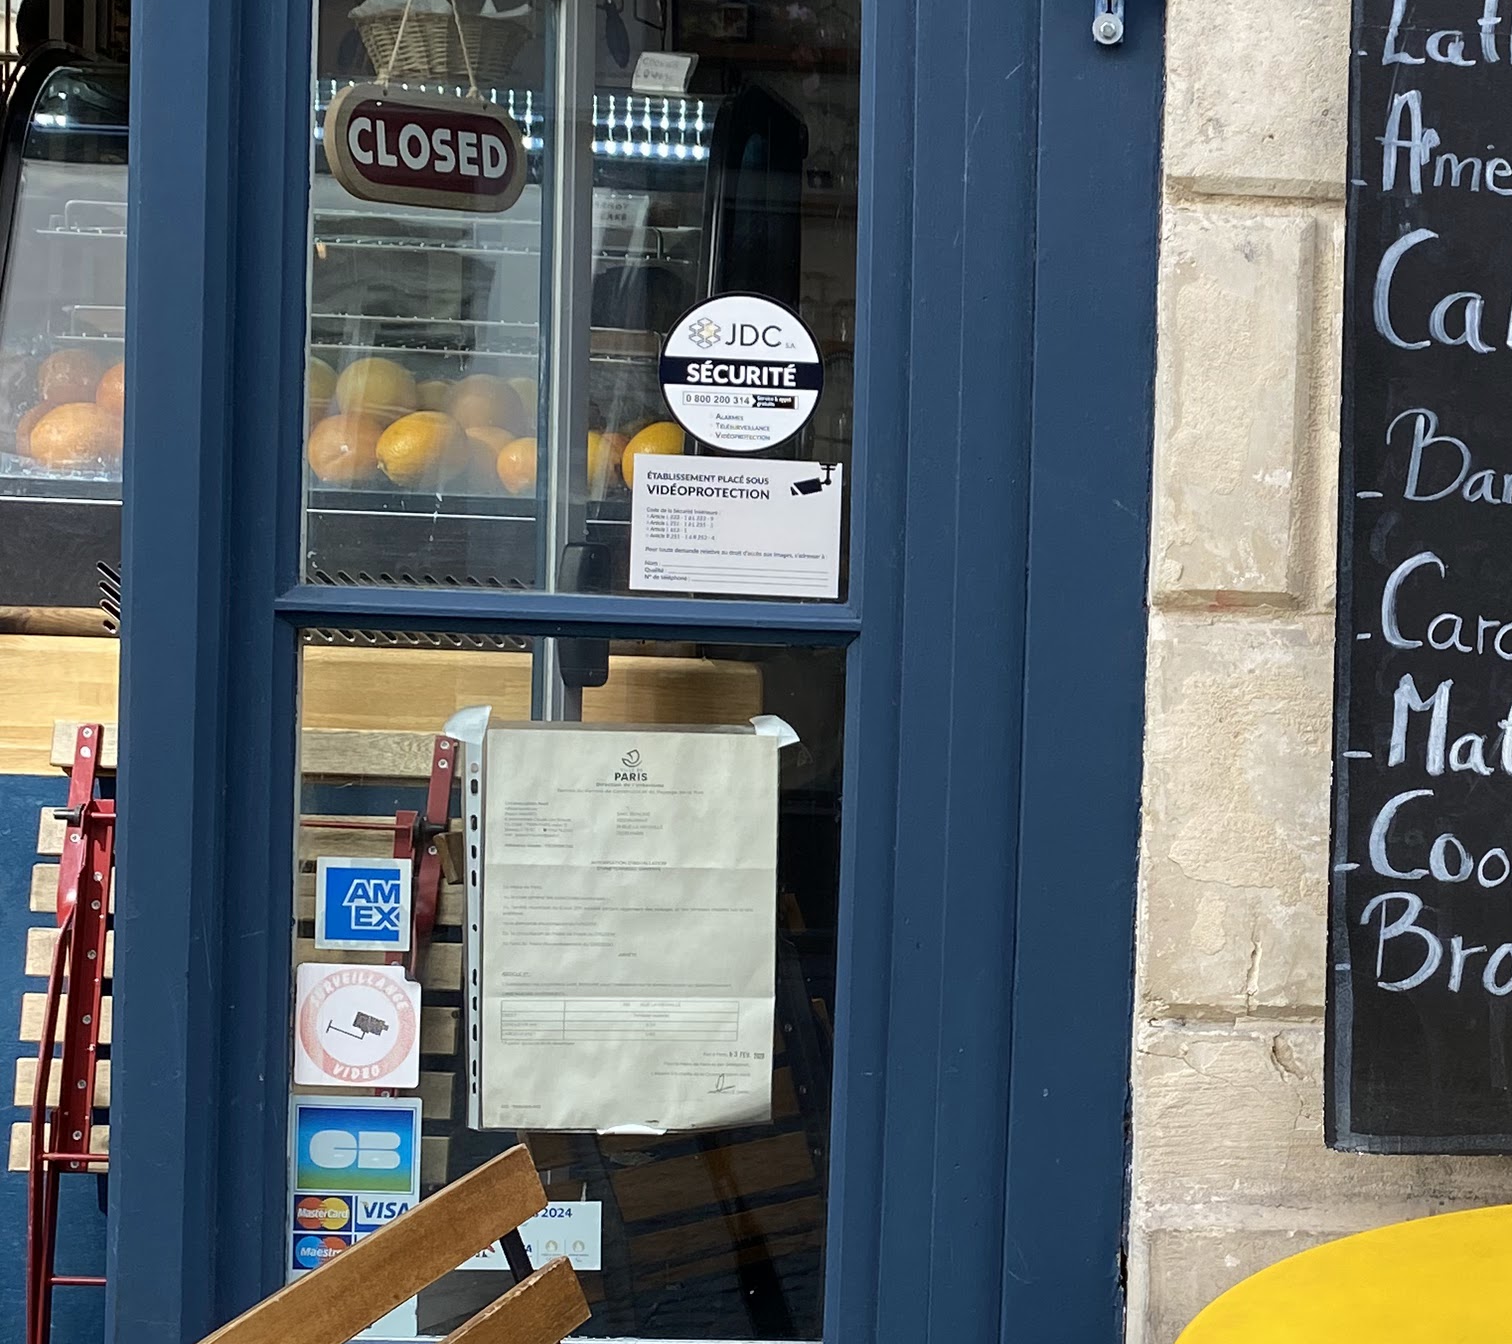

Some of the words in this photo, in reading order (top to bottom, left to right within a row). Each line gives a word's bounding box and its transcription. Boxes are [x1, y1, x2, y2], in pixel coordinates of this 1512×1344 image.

[348, 115, 508, 179] CLOSED
[725, 323, 782, 348] JDC
[687, 360, 797, 387] SÉCURITÉ
[694, 394, 711, 403] 800
[733, 395, 750, 404] 314
[647, 470, 716, 484] ÉTABLISSEMENT
[717, 474, 744, 484] PLACÉ
[746, 476, 769, 485] SOUS
[646, 483, 770, 500] VIDÉOPROTECTION
[614, 772, 648, 782] PARIS
[309, 1129, 401, 1170] CB
[297, 1207, 350, 1220] MasterCard
[361, 1201, 410, 1219] VISA
[541, 1207, 573, 1219] 2024
